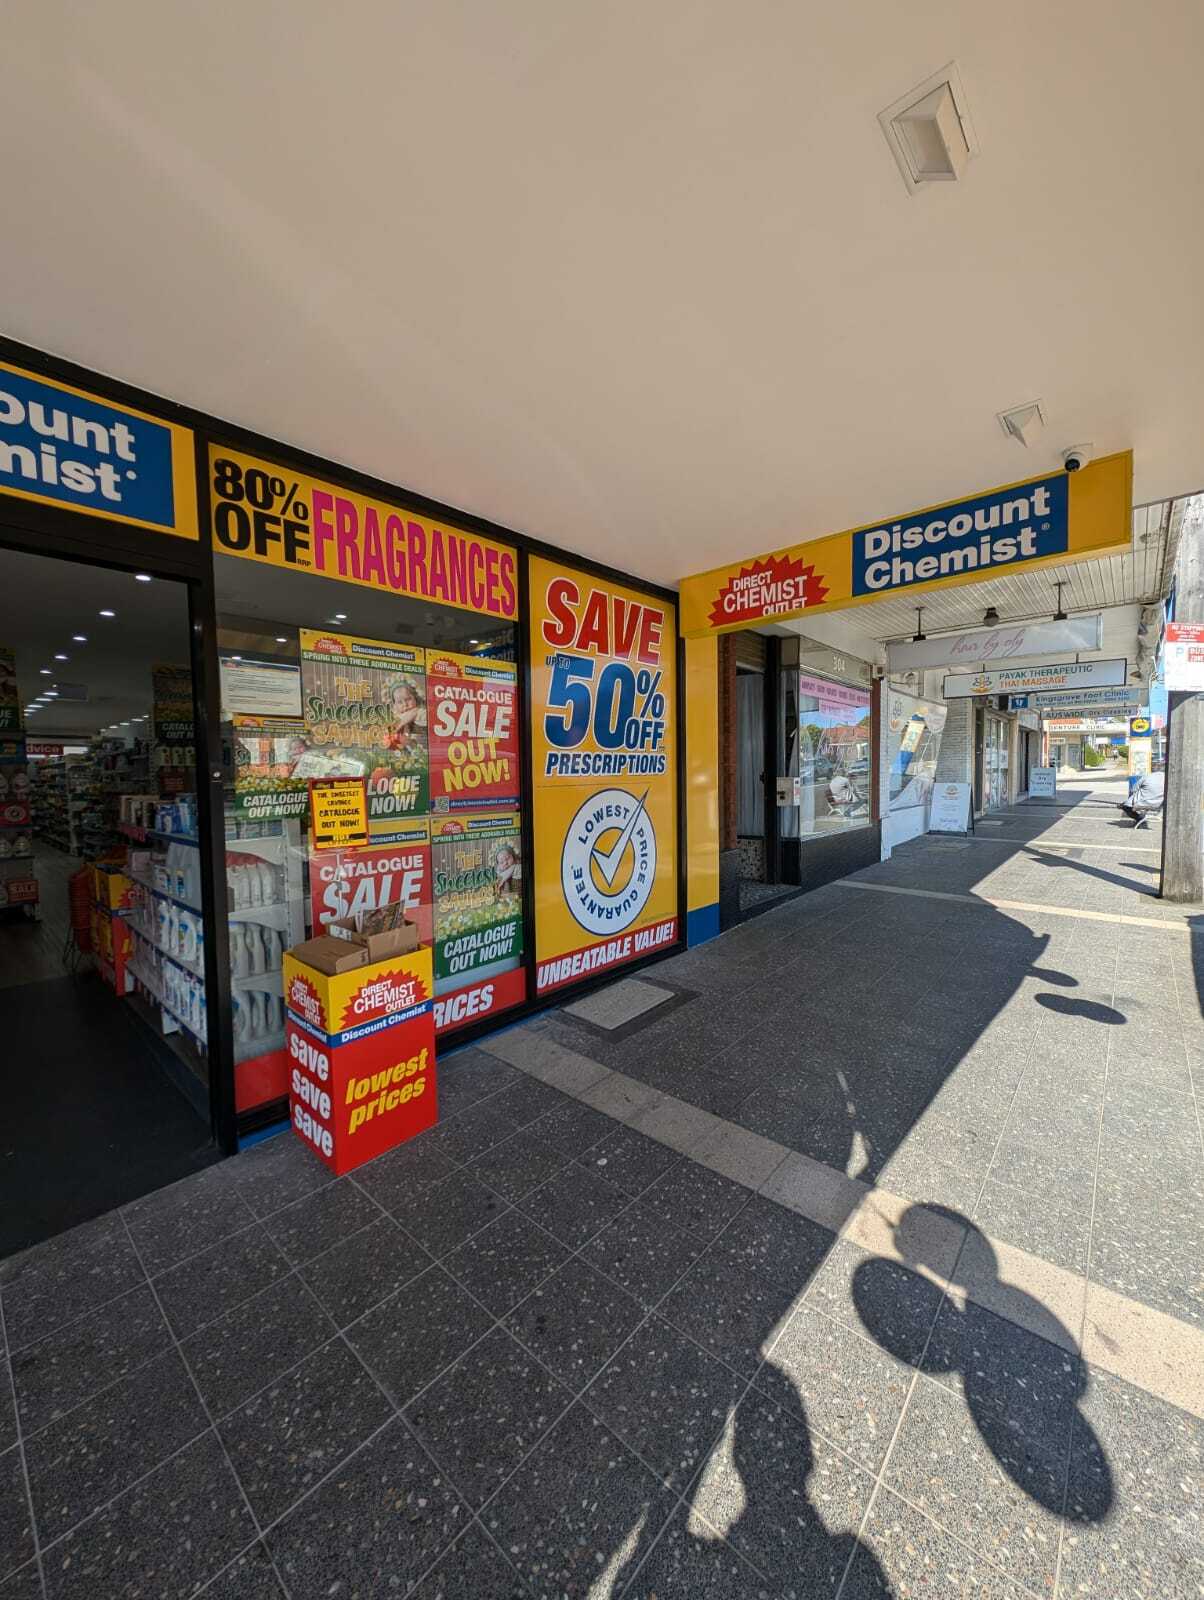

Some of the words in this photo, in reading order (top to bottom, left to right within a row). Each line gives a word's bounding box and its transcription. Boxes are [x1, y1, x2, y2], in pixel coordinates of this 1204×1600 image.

[214, 458, 309, 521] 80%
[214, 501, 310, 564] OFF
[864, 486, 1050, 559] Discount
[312, 489, 516, 617] FRAGRANCES
[864, 526, 1037, 589] Chemist
[723, 576, 807, 613] CHEMIST
[732, 569, 772, 592] DIRECT
[542, 576, 664, 667] SAVE
[762, 597, 807, 616] OUTLET
[352, 644, 384, 656] Discount
[385, 649, 415, 660] Chemist
[545, 655, 556, 666] UP
[557, 656, 571, 670] TO
[999, 671, 1027, 681] PAYAK
[1029, 664, 1093, 678] THERAPEUTIC
[1001, 680, 1020, 689] THAI
[1022, 675, 1068, 687] MASSAGE
[434, 685, 512, 705] CATALOGUE
[543, 652, 665, 751] 50%
[1104, 689, 1130, 698] Clinic
[433, 700, 512, 740] SALE
[624, 717, 665, 751] OFF
[448, 737, 500, 767] OUT
[545, 751, 667, 777] PRESCRIPTIONS
[367, 775, 421, 797] LOGUE
[443, 759, 511, 793] NOW!
[243, 791, 309, 808] CATALOGUE
[248, 805, 273, 818] OUT
[274, 803, 306, 816] NOW!
[370, 794, 417, 816] NOW!
[396, 831, 426, 841] Chemist
[578, 804, 630, 845] LOWEST
[320, 855, 423, 880] CATALOGUE
[635, 827, 650, 883] PRICE
[319, 871, 422, 922] SALE
[572, 866, 638, 919] GUARANTEE
[443, 920, 517, 958] CATALOGUE
[450, 953, 475, 974] OUT
[479, 938, 514, 960] NOW!
[536, 937, 632, 989] UNBEATABLE
[634, 921, 675, 953] VALUE!
[353, 981, 416, 1014] CHEMIST
[361, 979, 393, 996] DIRECT
[385, 995, 417, 1014] OUTLET
[341, 1019, 387, 1043] Discount
[388, 1004, 427, 1026] Chemist
[433, 985, 494, 1029] RICES
[290, 1032, 330, 1082] save
[345, 1047, 429, 1105] lowest
[292, 1068, 331, 1121] save
[348, 1076, 426, 1135] prices
[294, 1104, 333, 1158] save
